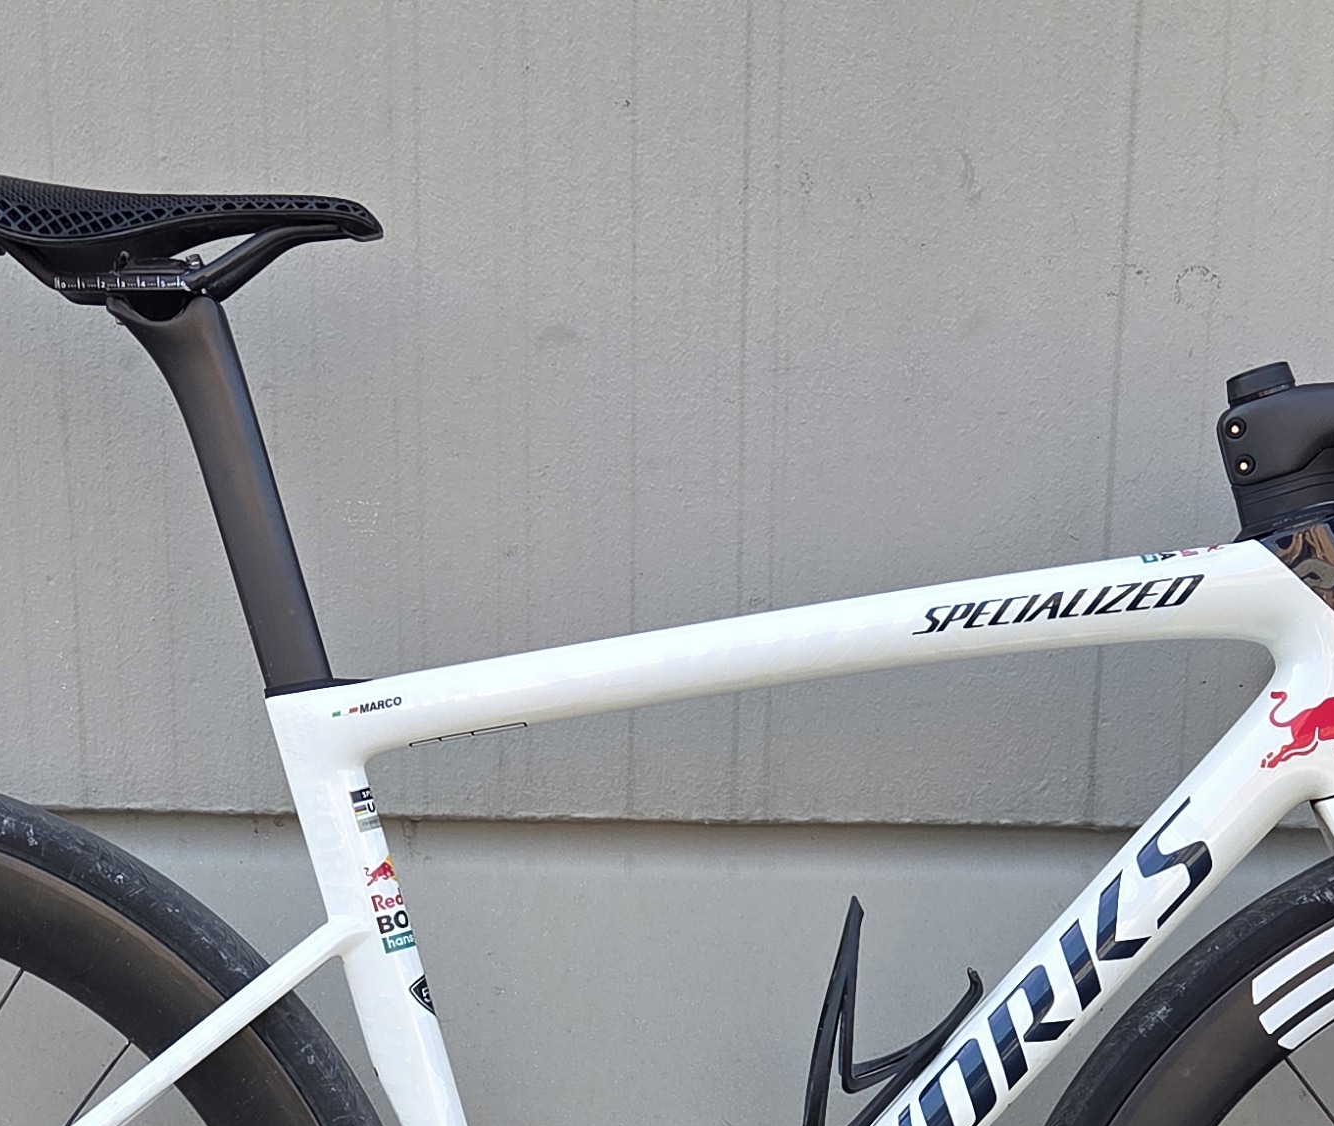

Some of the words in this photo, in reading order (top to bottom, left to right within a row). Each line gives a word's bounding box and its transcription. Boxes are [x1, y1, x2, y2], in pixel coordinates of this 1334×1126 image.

[912, 574, 1204, 635] SPECIALIZED
[360, 696, 402, 714] MARCO
[371, 887, 404, 912] Red
